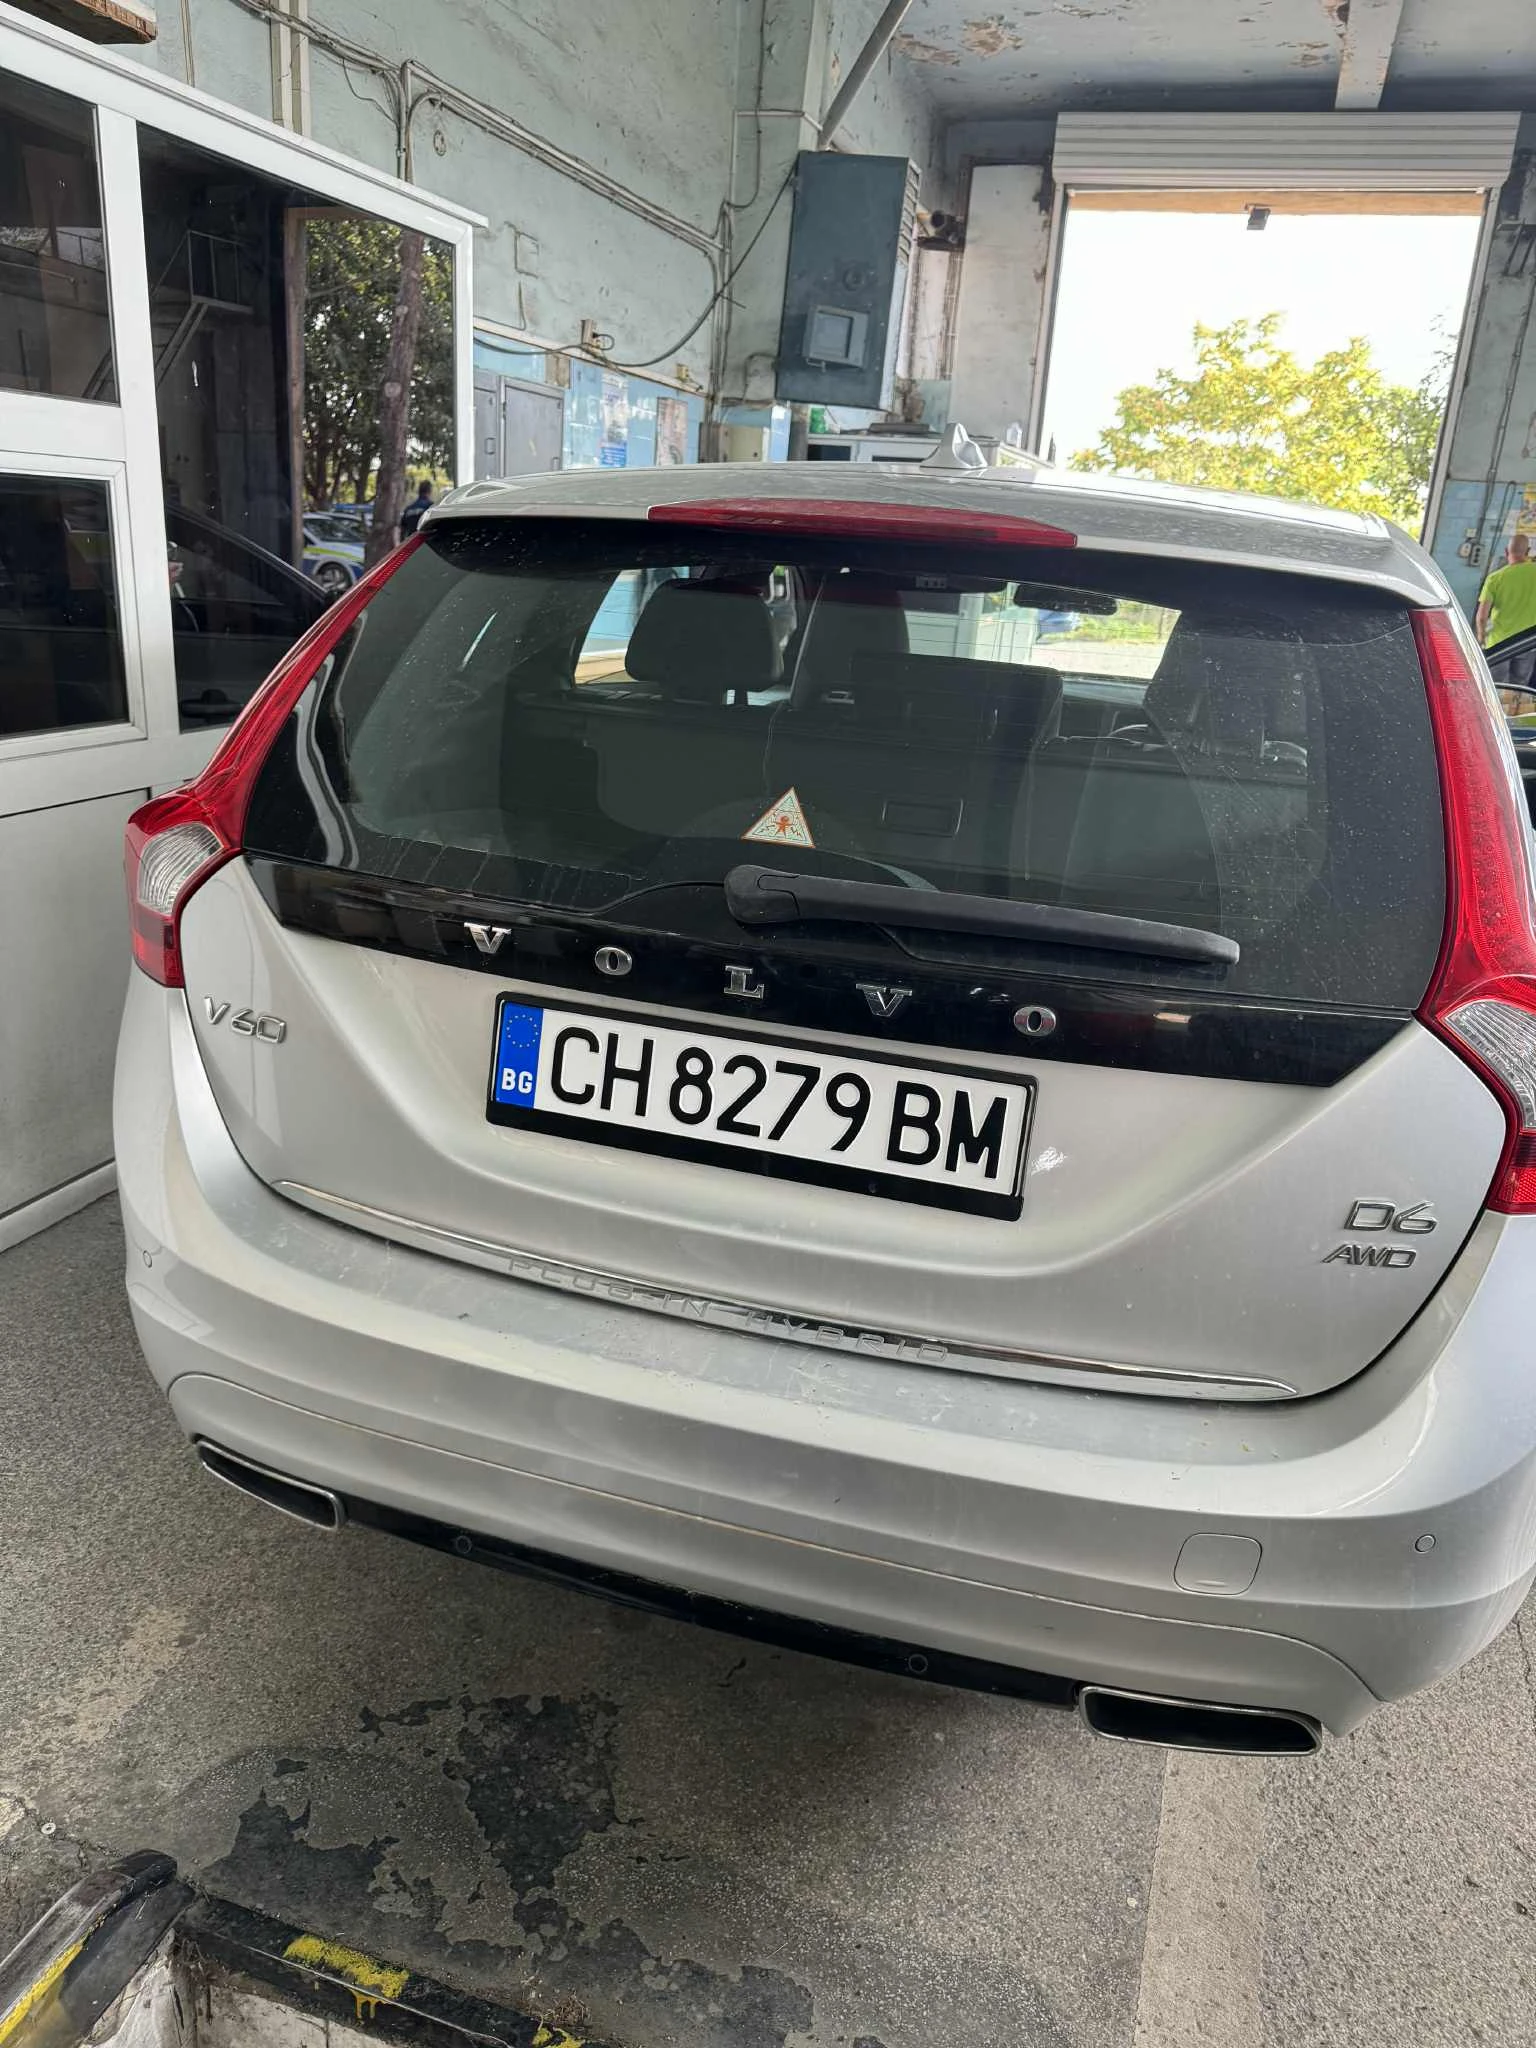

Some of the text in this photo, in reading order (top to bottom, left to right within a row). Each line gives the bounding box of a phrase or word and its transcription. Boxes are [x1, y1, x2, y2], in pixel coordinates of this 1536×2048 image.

[464, 921, 1057, 1036] VOLVO
[203, 996, 287, 1044] V60
[501, 1067, 533, 1094] BG
[551, 1026, 1008, 1179] CH 8279 BM
[1343, 1199, 1437, 1234] D6
[1320, 1243, 1417, 1268] AWD
[745, 1310, 949, 1363] HYBRID
